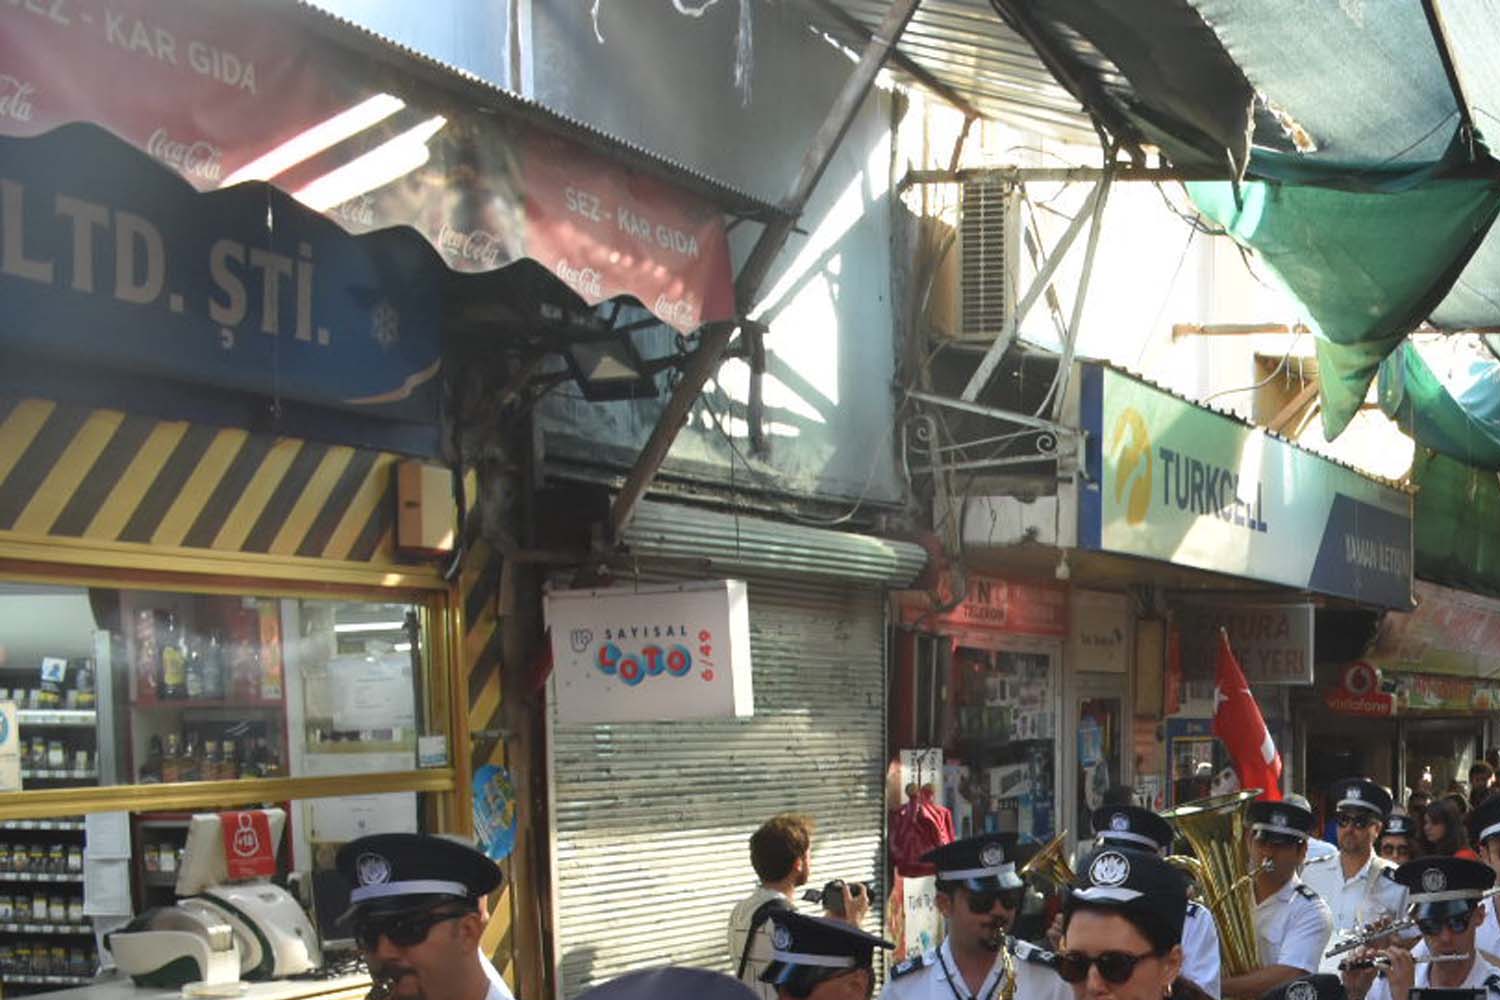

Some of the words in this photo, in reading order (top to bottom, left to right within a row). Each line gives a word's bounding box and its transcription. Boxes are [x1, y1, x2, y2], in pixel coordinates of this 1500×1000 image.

[105, 7, 178, 64] KAR
[188, 42, 258, 95] GIDA
[0, 178, 185, 313] LTD.
[207, 238, 330, 350] ŞTİ.
[616, 206, 652, 243] KAR
[656, 223, 699, 259] GIDA
[1159, 447, 1268, 533] TURKCELL
[596, 642, 692, 685] LOTO
[603, 624, 688, 641] SAYISAL
